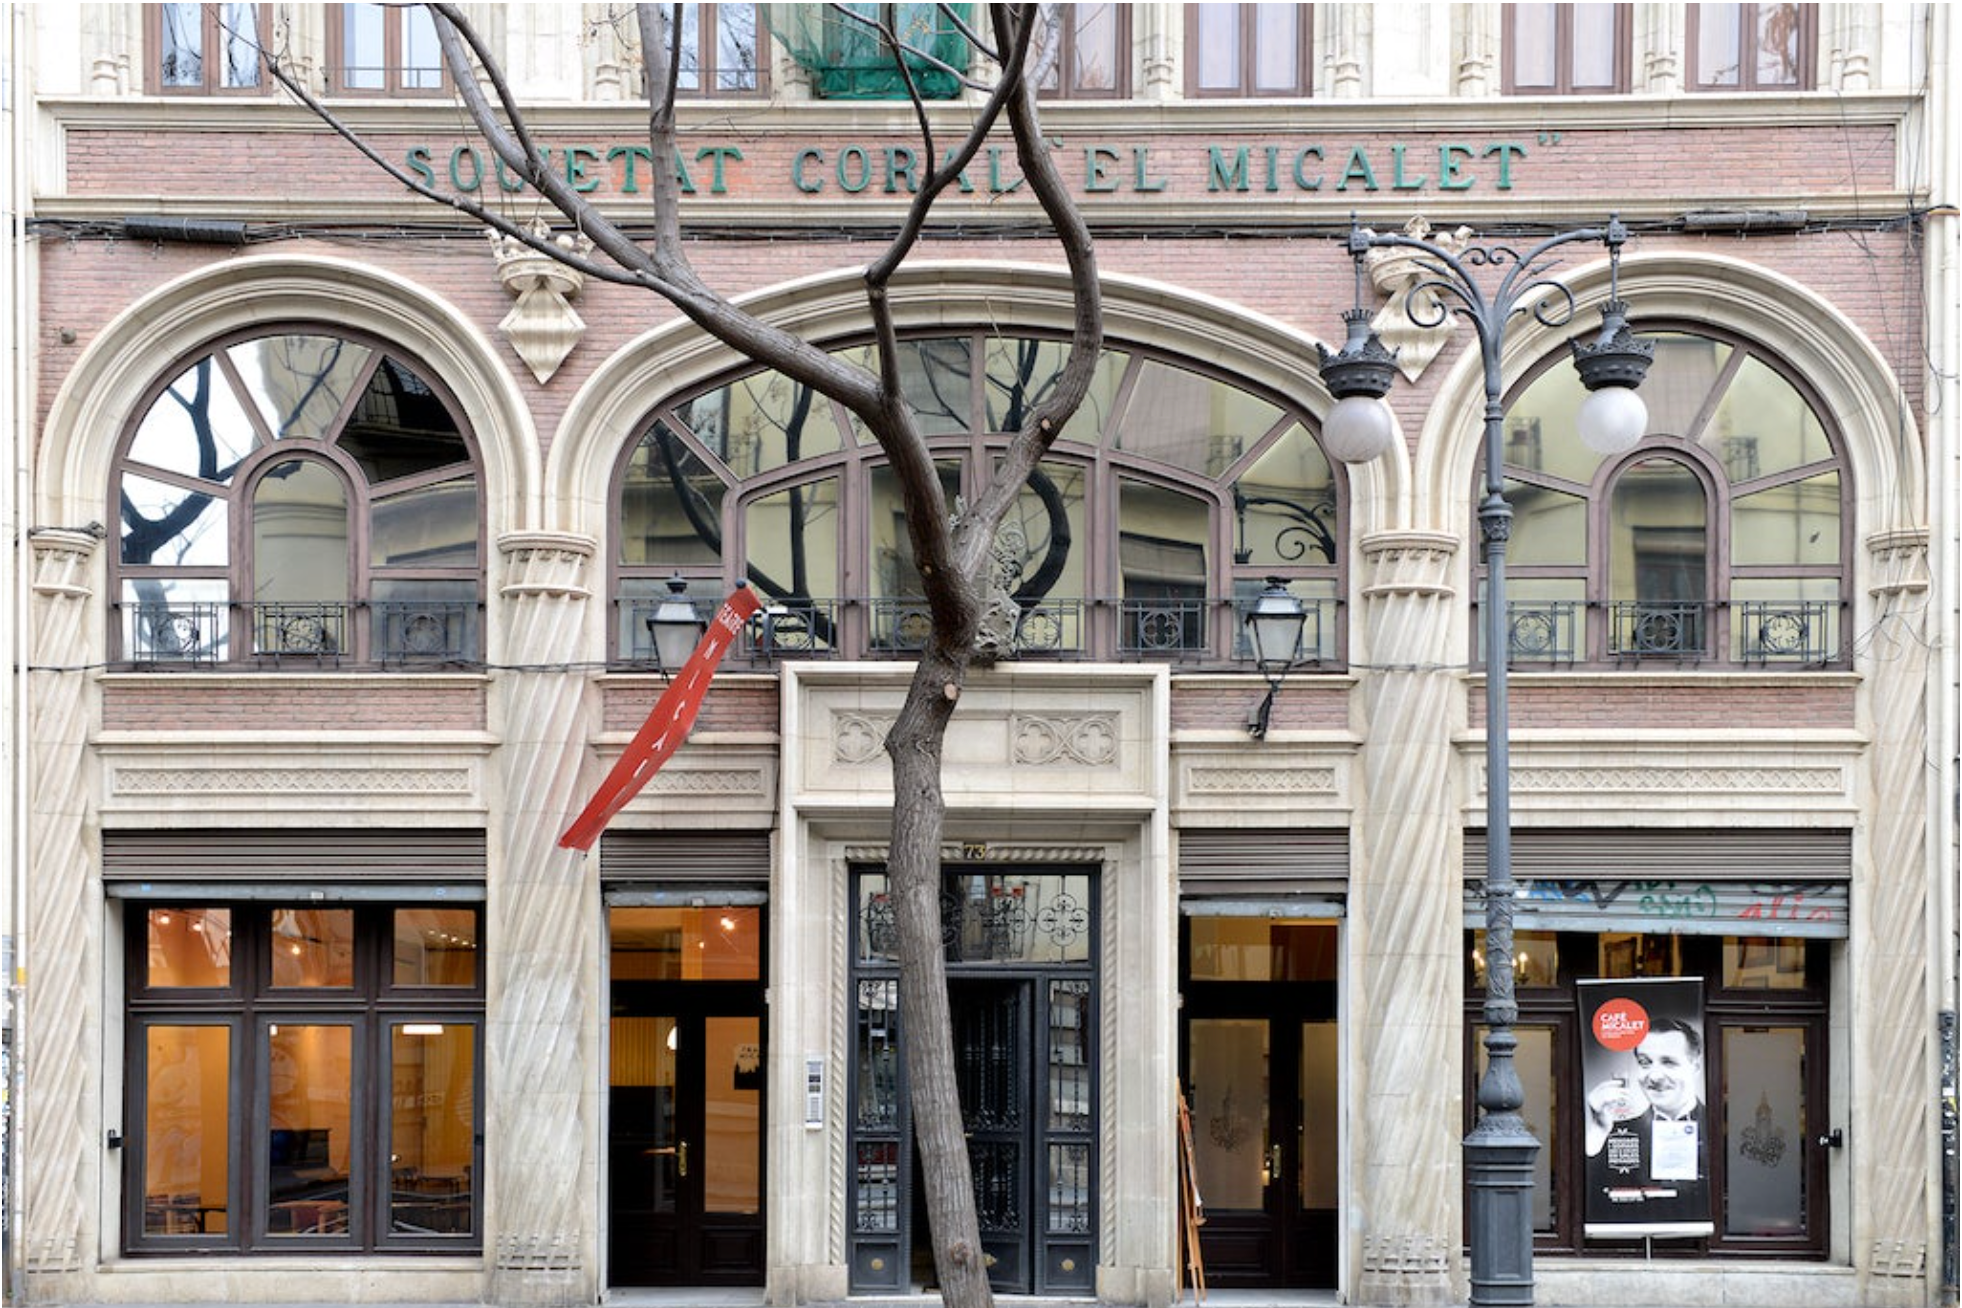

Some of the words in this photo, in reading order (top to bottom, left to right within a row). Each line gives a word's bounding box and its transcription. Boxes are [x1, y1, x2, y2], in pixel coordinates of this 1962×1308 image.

[406, 145, 743, 193] SOCETAT
[792, 145, 1025, 193] CORAL
[964, 844, 986, 859] 73
[1601, 1019, 1645, 1031] MICALET
